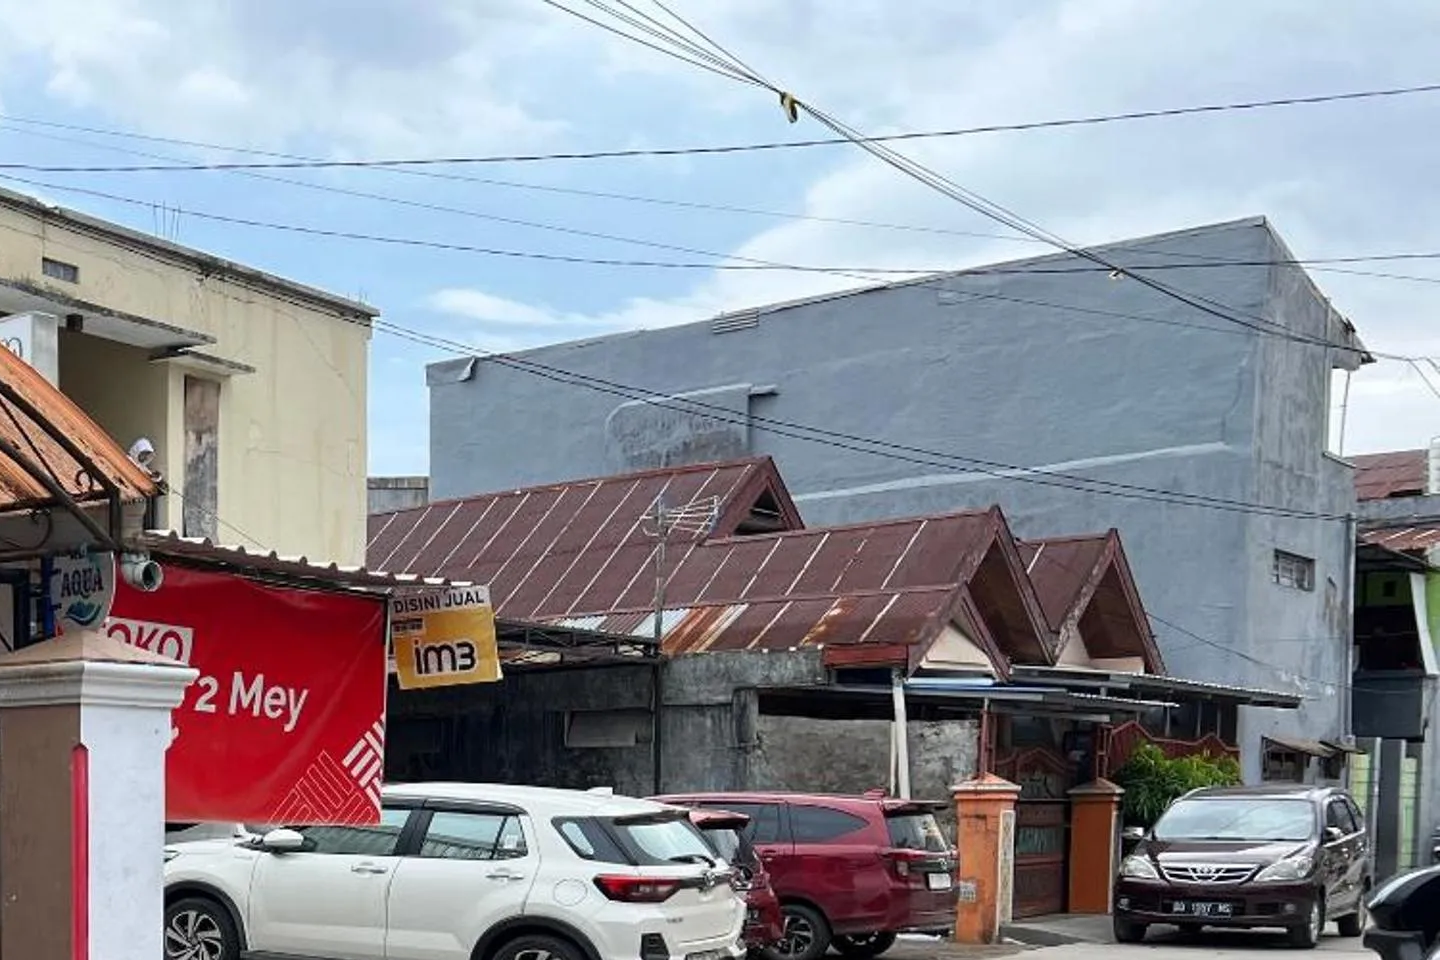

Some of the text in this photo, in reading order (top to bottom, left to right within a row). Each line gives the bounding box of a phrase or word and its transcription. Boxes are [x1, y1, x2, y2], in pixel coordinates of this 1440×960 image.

[60, 566, 104, 599] AQUA
[393, 590, 484, 614] DISINI JUAL
[101, 622, 184, 661] OKO
[413, 639, 477, 675] im3
[228, 671, 309, 732] Mey
